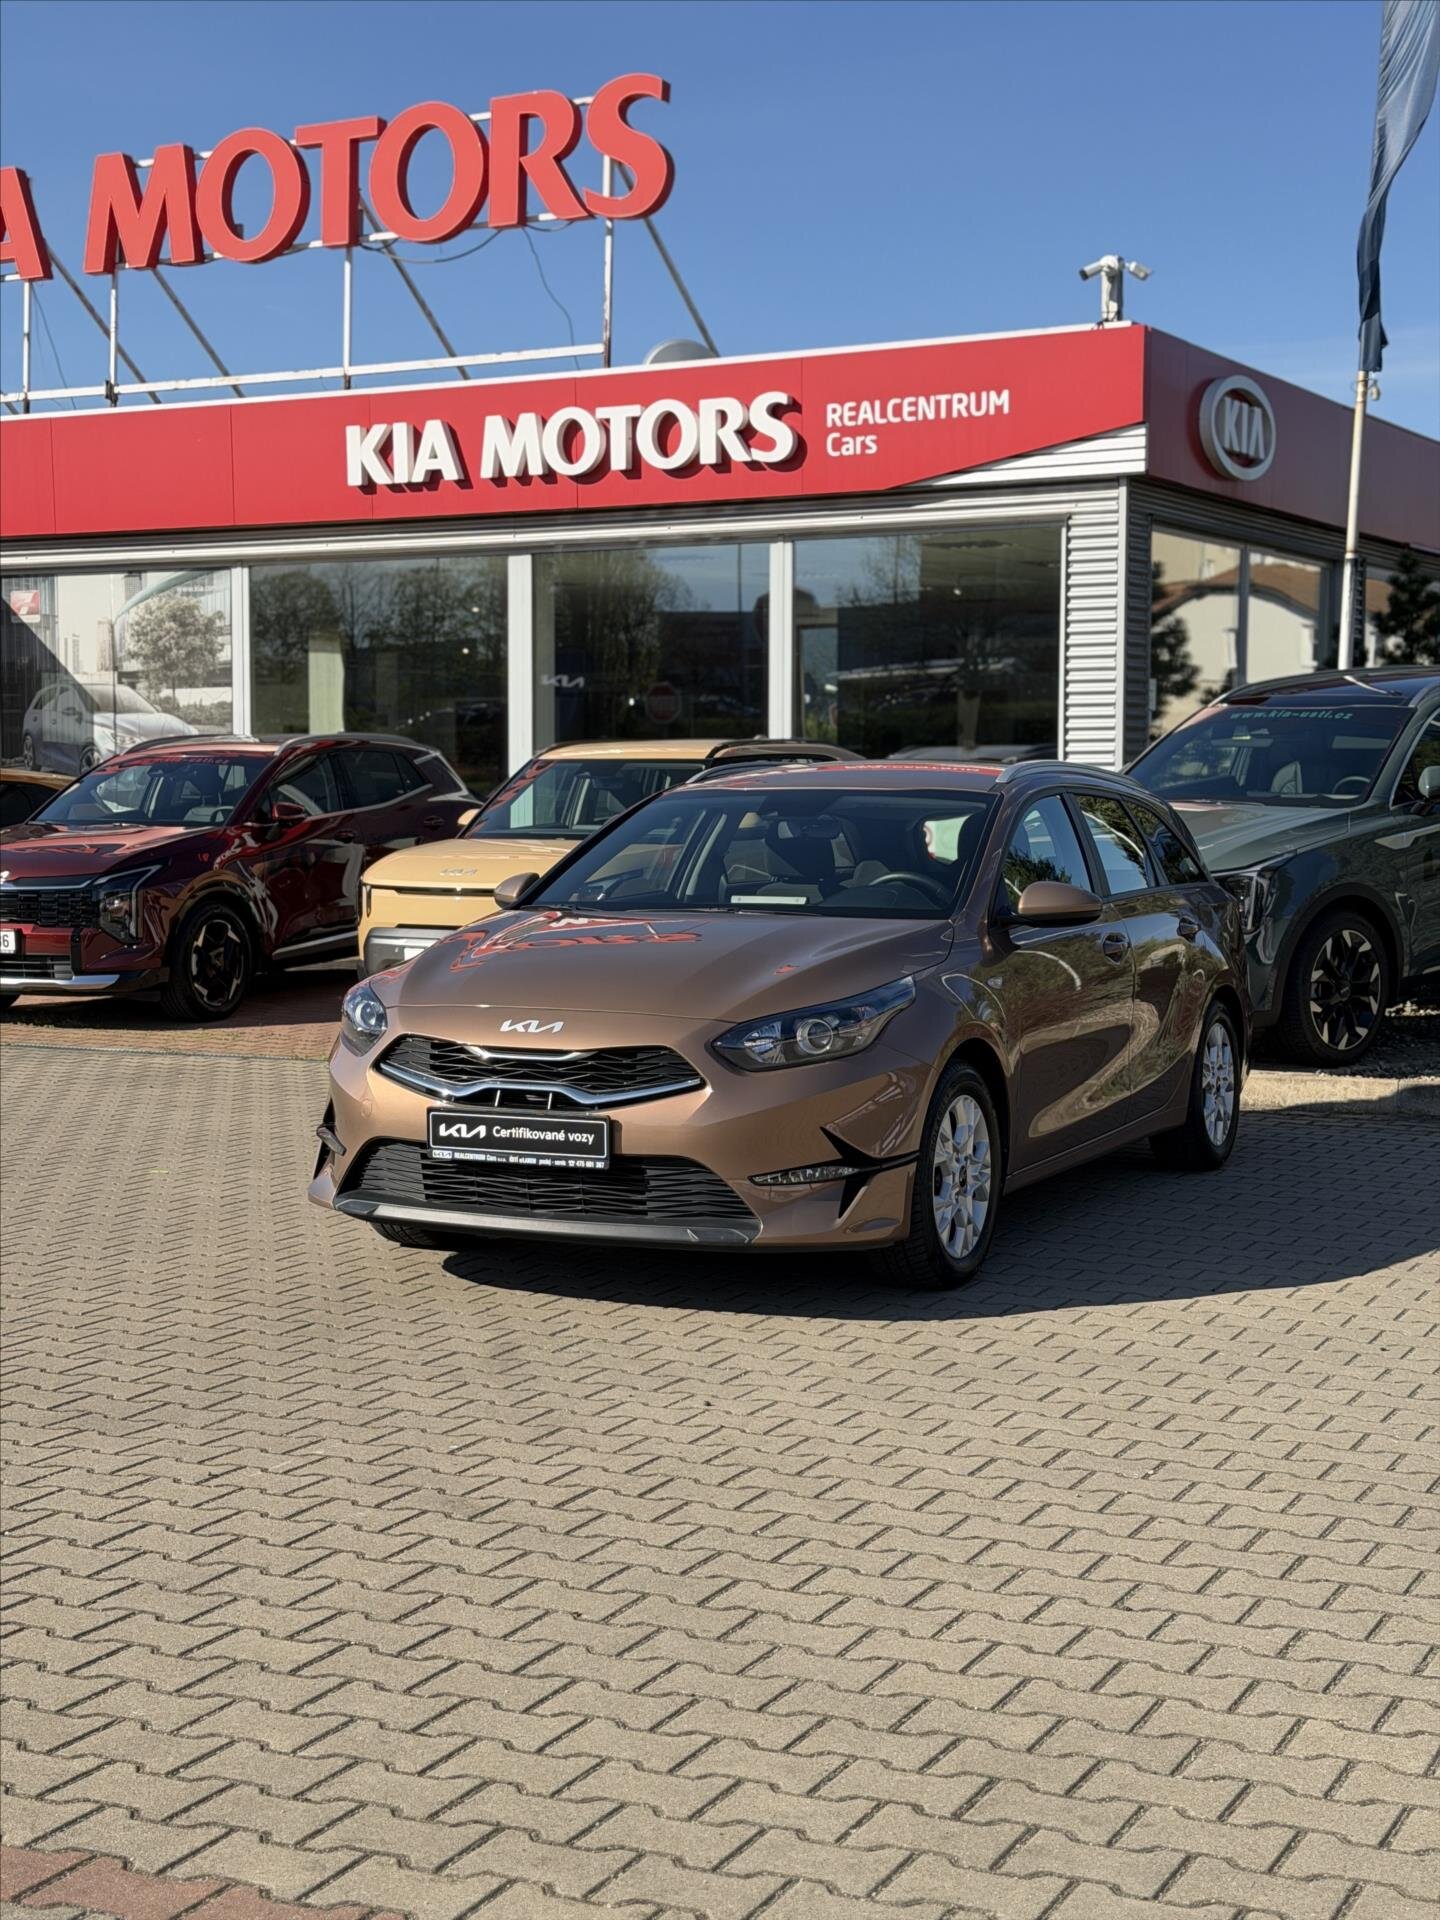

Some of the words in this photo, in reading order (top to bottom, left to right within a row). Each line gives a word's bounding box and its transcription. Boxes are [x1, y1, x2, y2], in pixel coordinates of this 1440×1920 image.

[83, 73, 673, 275] MOTORS
[826, 389, 1010, 429] REALCENTRUM
[1221, 396, 1266, 462] KIA
[345, 418, 465, 488] KIA
[480, 390, 801, 480] MOTORS
[826, 431, 878, 458] Cars
[492, 1125, 566, 1142] Certifikované
[568, 1132, 595, 1146] vozy
